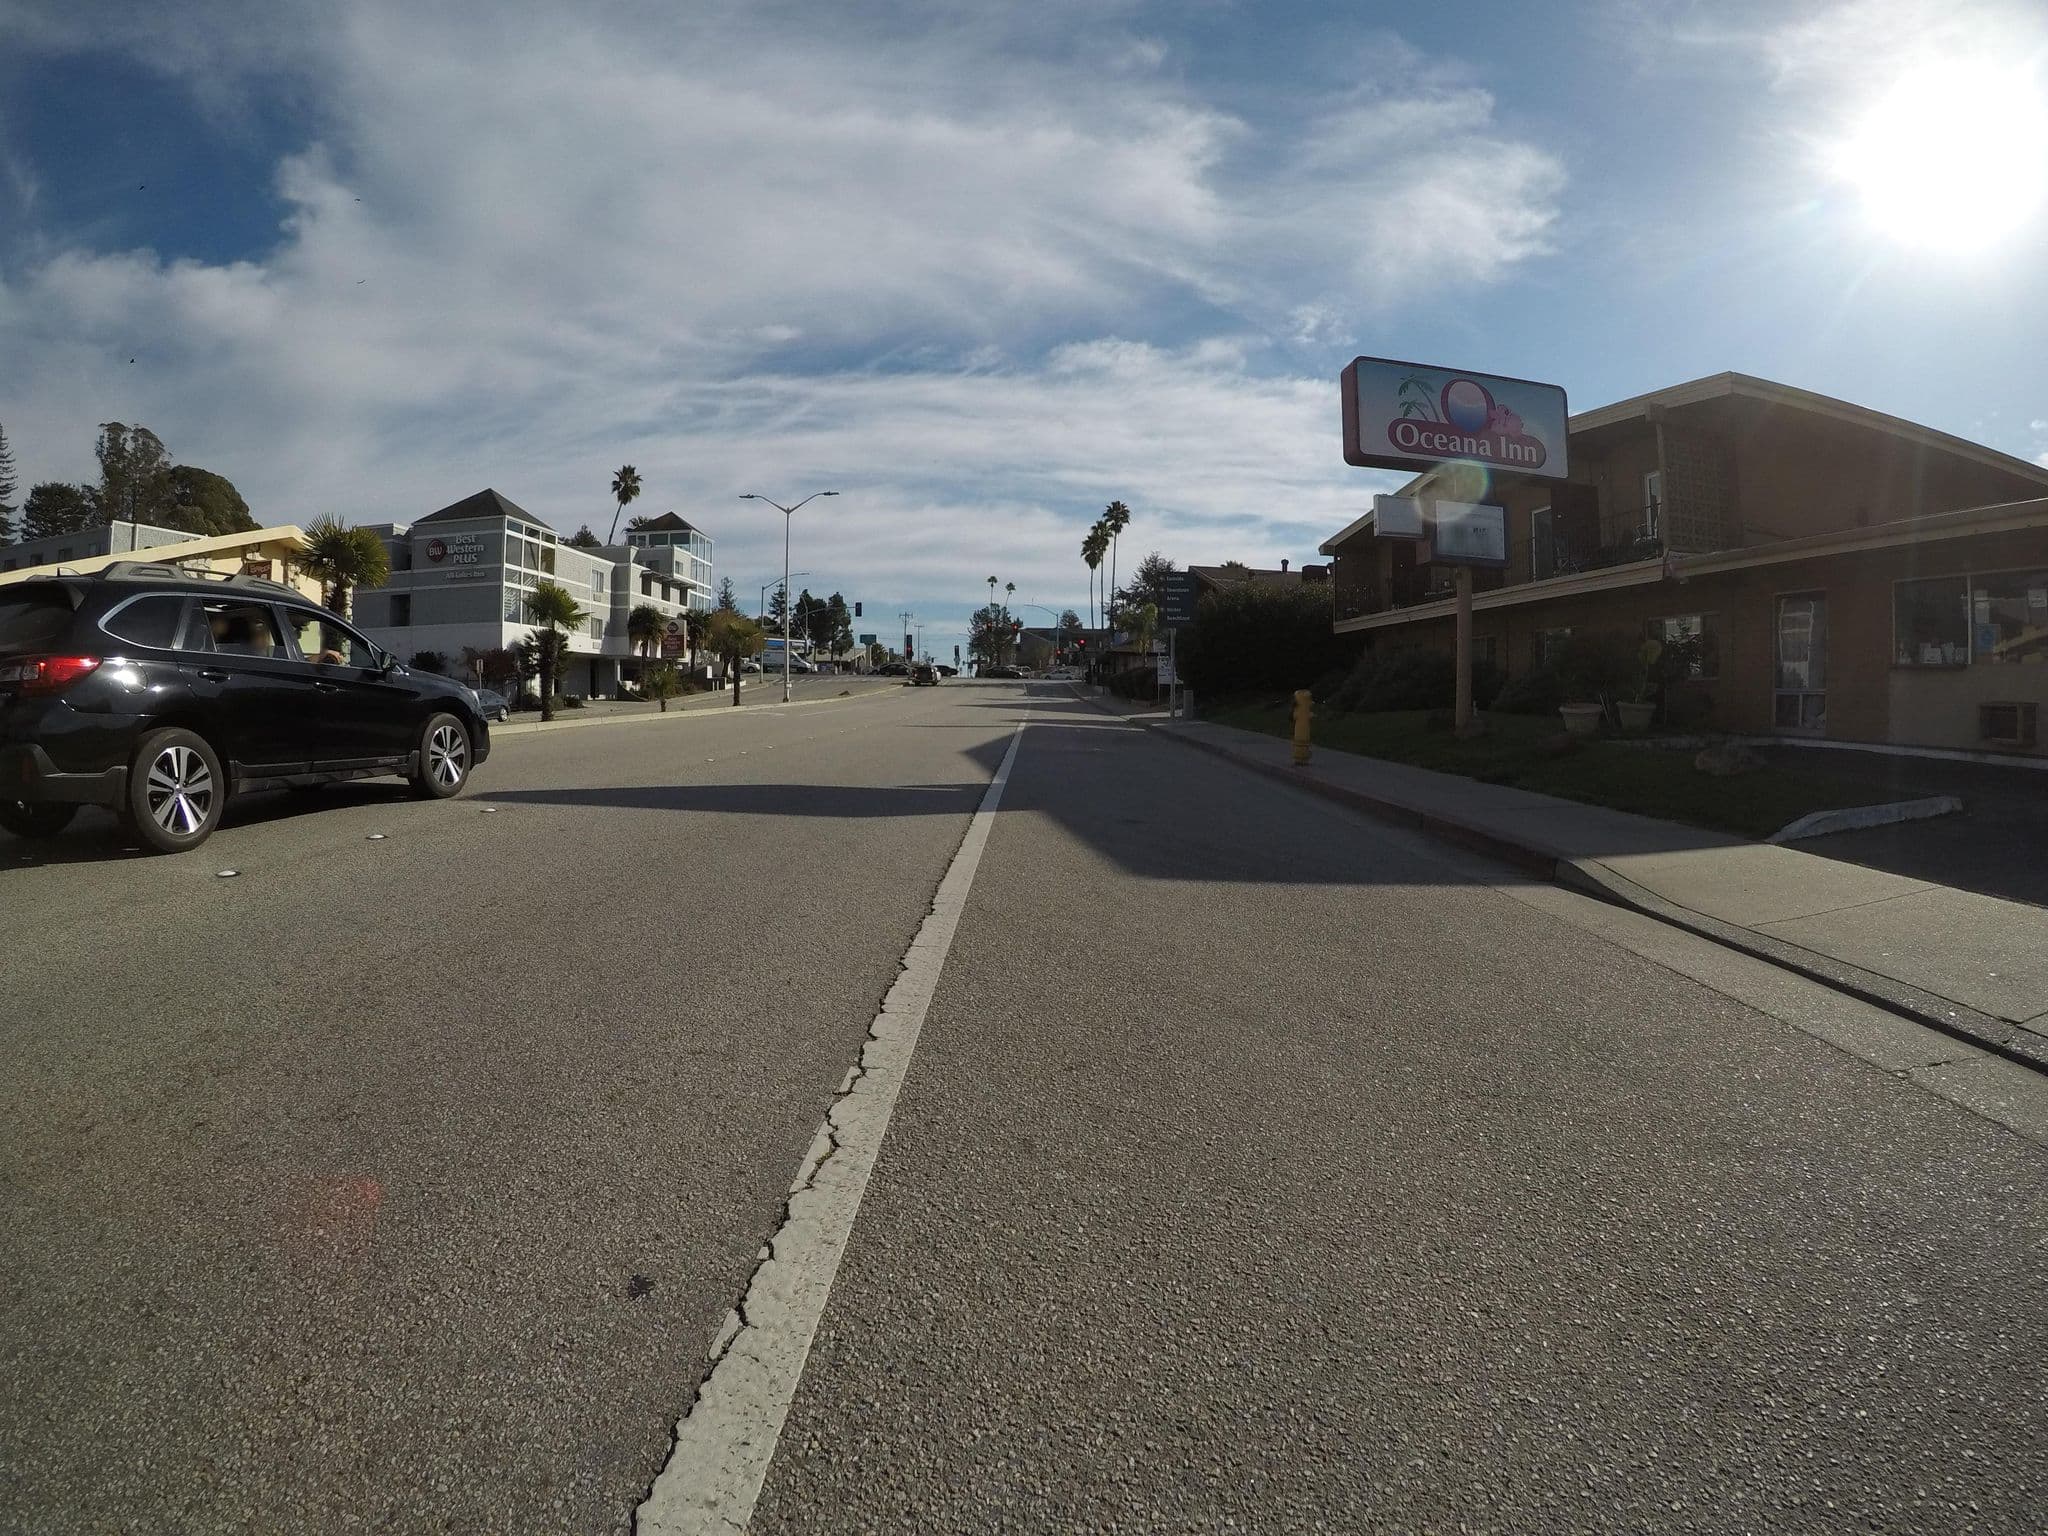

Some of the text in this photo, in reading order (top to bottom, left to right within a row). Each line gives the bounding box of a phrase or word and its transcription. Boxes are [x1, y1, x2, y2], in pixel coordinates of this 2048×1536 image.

[1395, 422, 1538, 464] Oceana Inn
[455, 535, 477, 544] Best
[428, 545, 443, 556] BW
[446, 544, 485, 554] Western
[453, 553, 478, 564] PLUS
